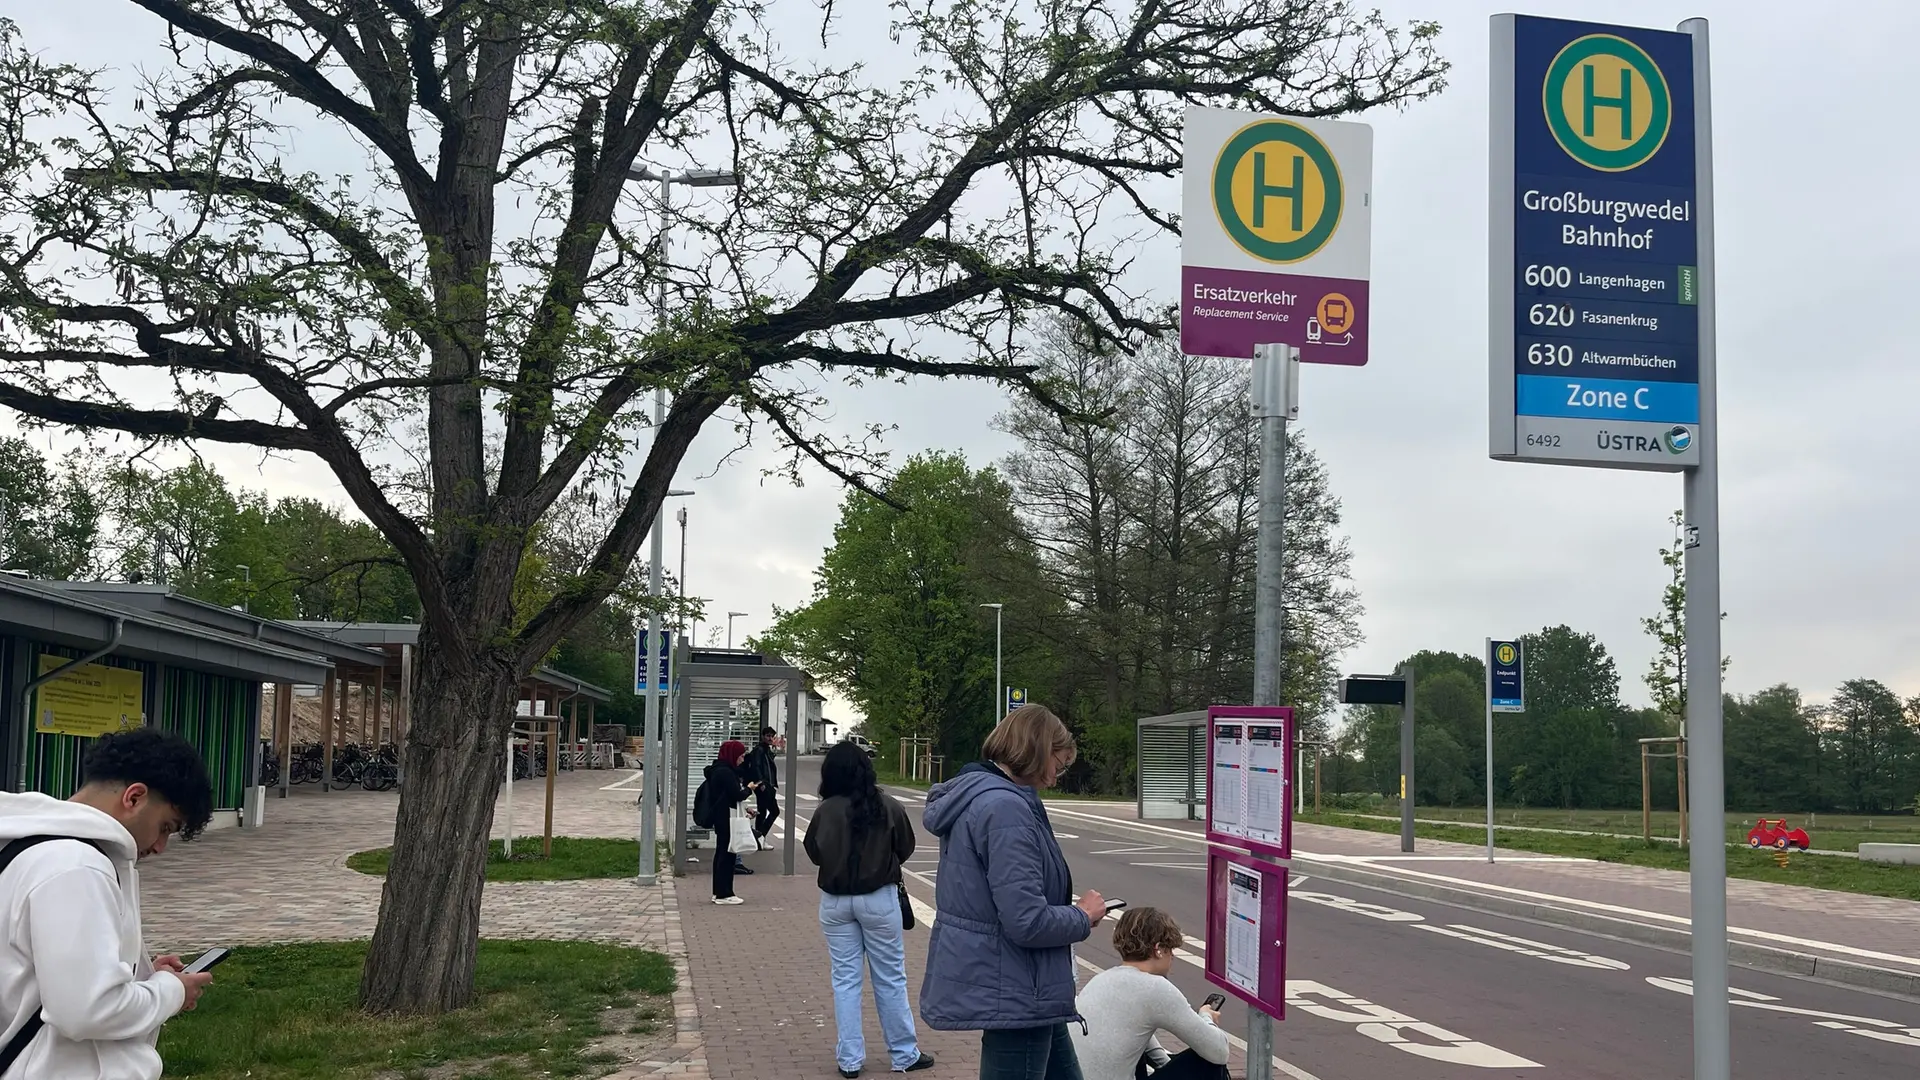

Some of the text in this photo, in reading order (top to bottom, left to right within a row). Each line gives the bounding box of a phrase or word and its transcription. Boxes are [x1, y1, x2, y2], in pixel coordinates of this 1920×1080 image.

[1583, 64, 1632, 141] H
[1253, 151, 1304, 232] H
[1523, 190, 1690, 223] Großburgwedel
[1562, 224, 1654, 250] Bahnhof
[1524, 264, 1665, 293] 600 Langenhagen
[1683, 269, 1693, 302] sprintH
[1194, 283, 1298, 306] Ersatzverkehr
[1193, 305, 1289, 322] Replacement Service
[1529, 303, 1658, 331] 620 Fasanenkrug
[1527, 343, 1677, 369] 630 Altwarmbüchen
[1566, 384, 1650, 410] Zone C
[1526, 430, 1662, 452] 6492 ÜSTRA
